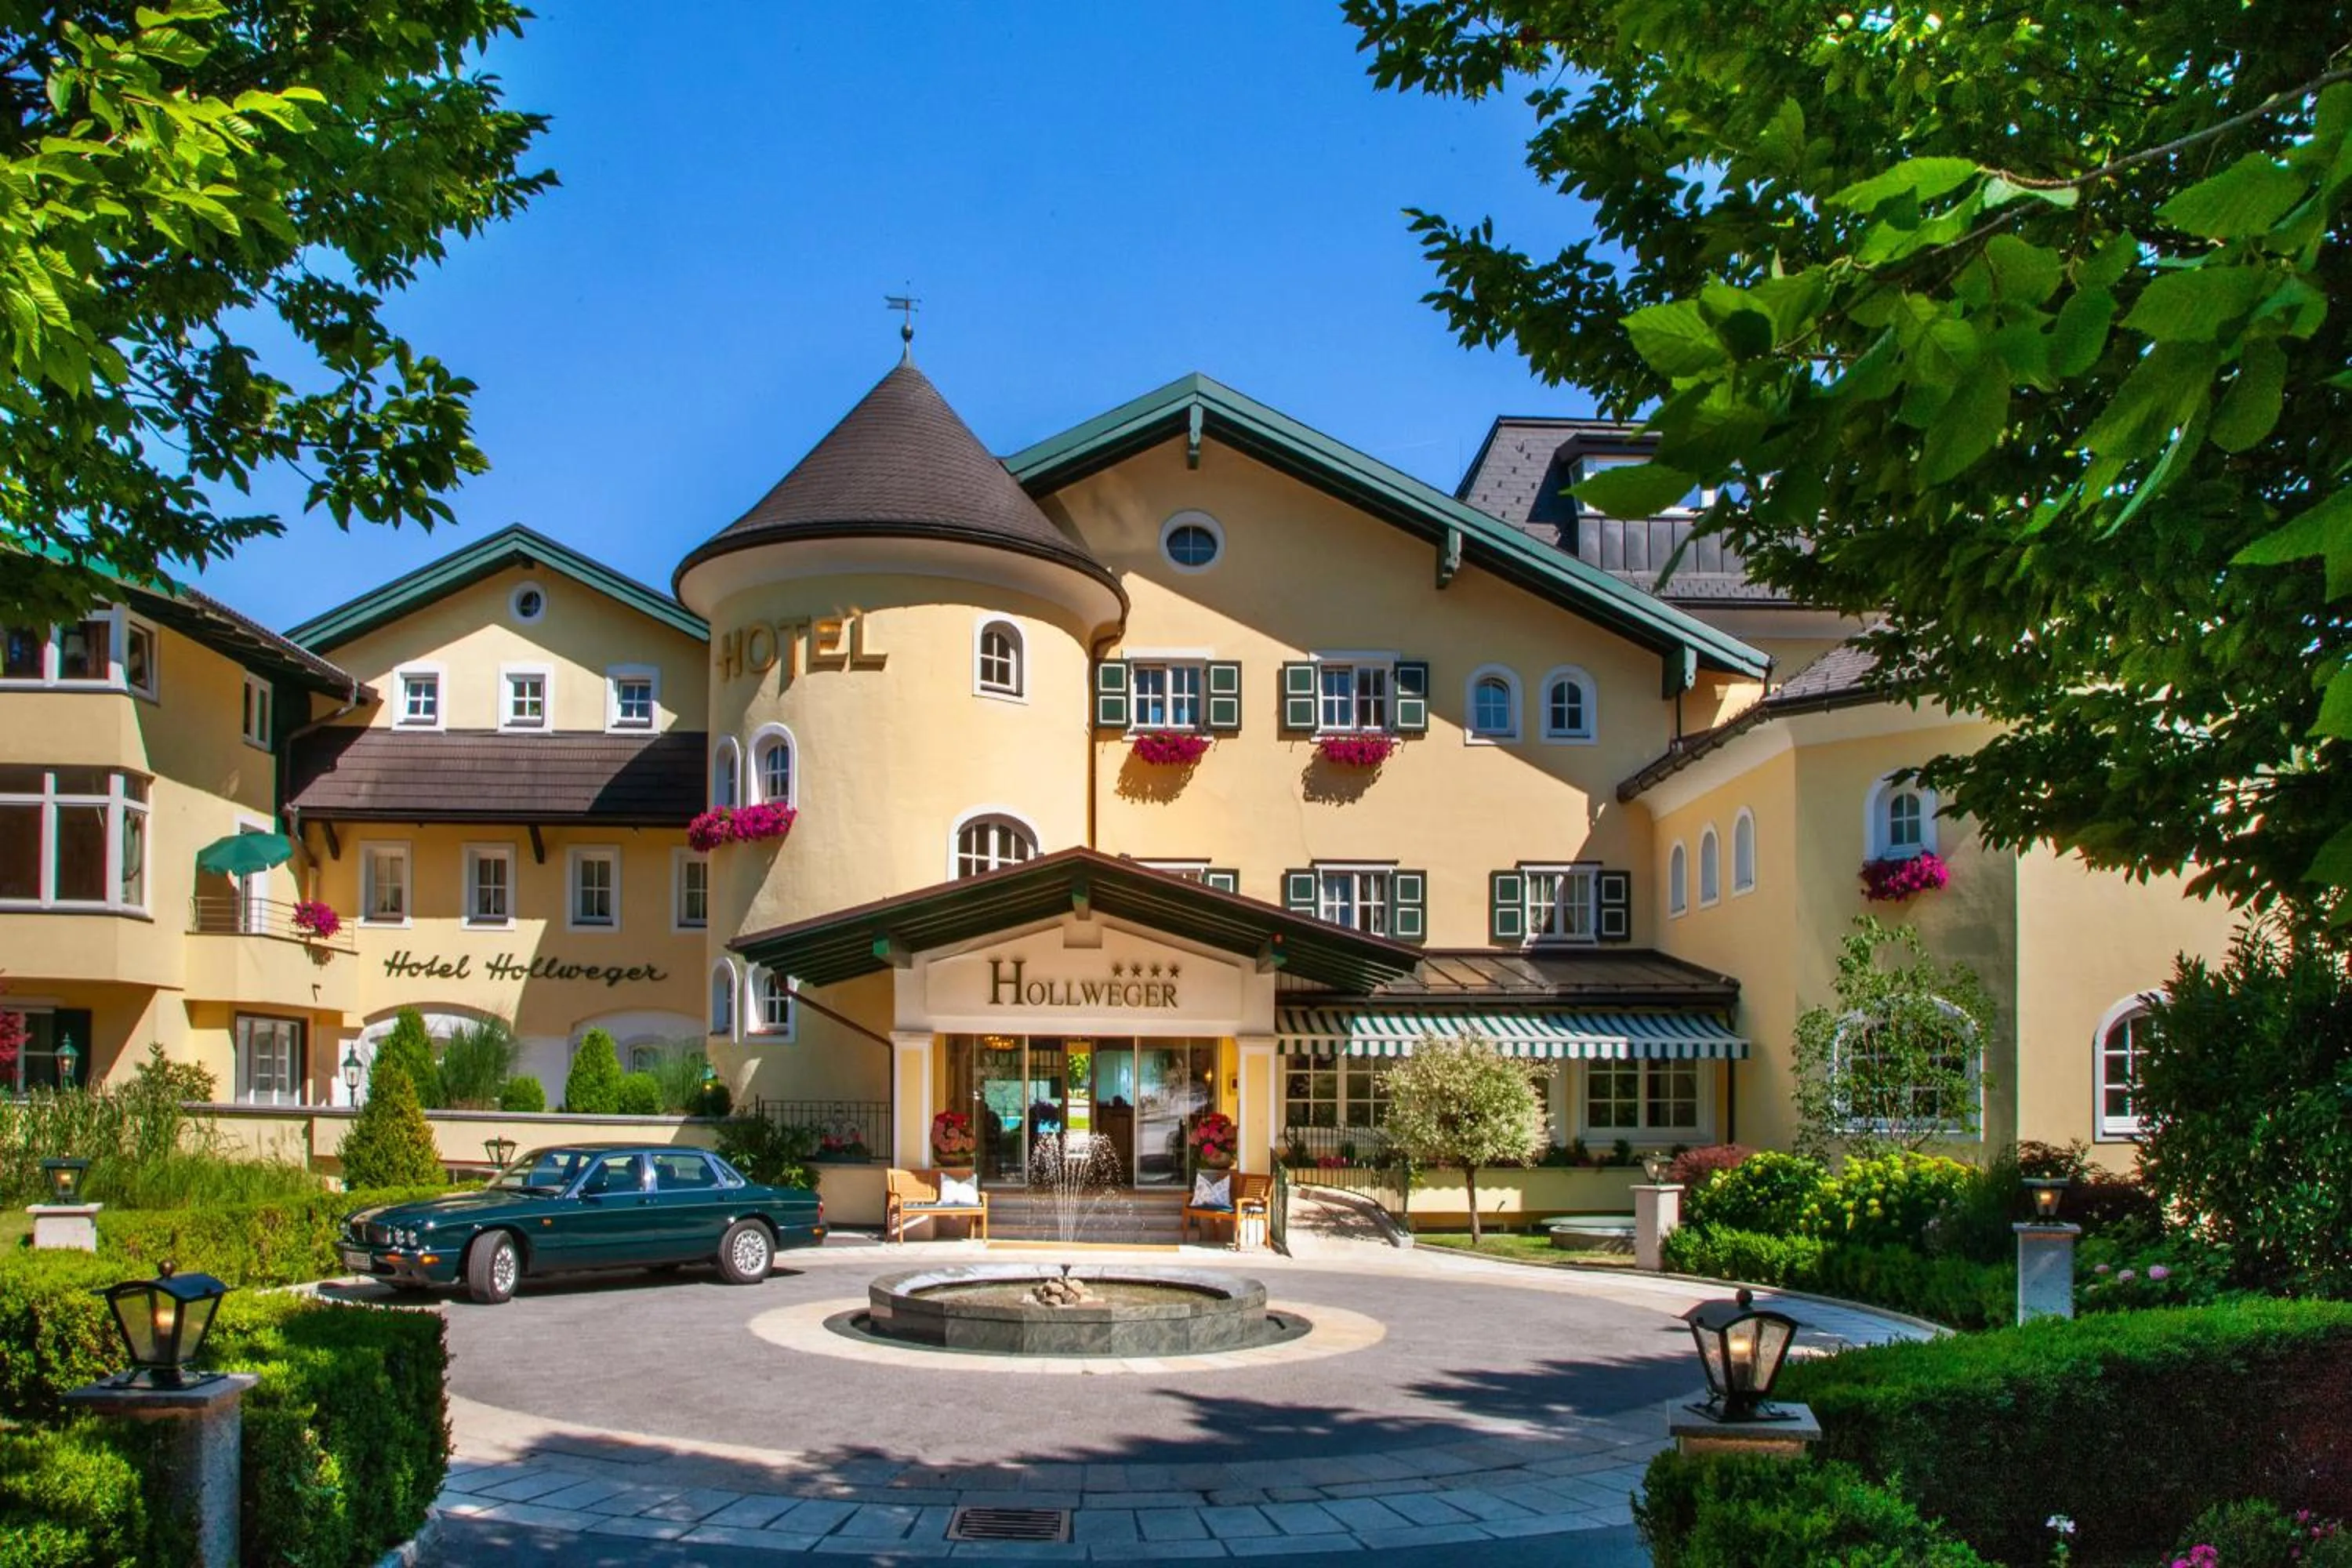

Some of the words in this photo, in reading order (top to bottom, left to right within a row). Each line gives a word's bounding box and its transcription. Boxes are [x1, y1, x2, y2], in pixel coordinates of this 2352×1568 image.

[717, 608, 887, 683] HOTEL
[383, 950, 470, 980] Hotel
[486, 953, 668, 987] Hollweger
[988, 958, 1179, 1008] HOLLWEGER
